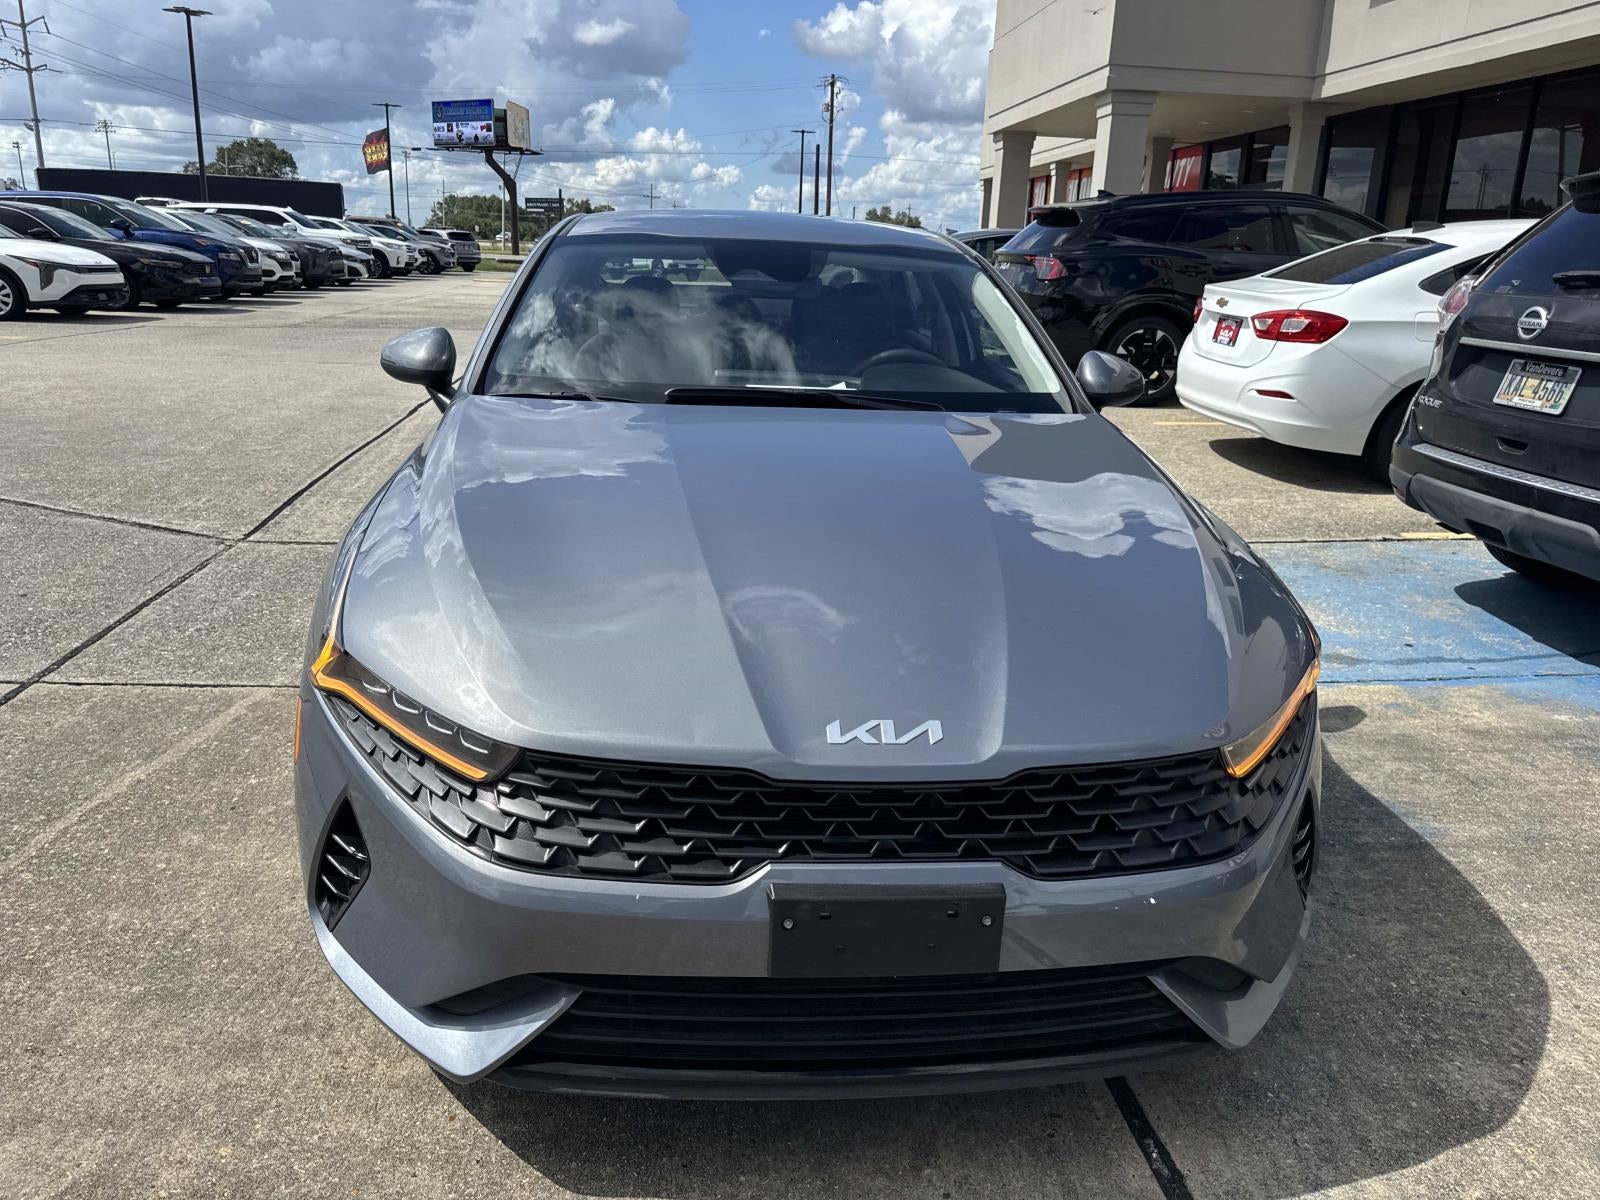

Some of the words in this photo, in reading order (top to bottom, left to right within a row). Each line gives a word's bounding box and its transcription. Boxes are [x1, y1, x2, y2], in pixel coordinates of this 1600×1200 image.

[1519, 320, 1542, 328] NISSAN
[1525, 361, 1564, 377] VanDevere
[1532, 377, 1568, 404] 4566
[826, 719, 943, 745] KIA
